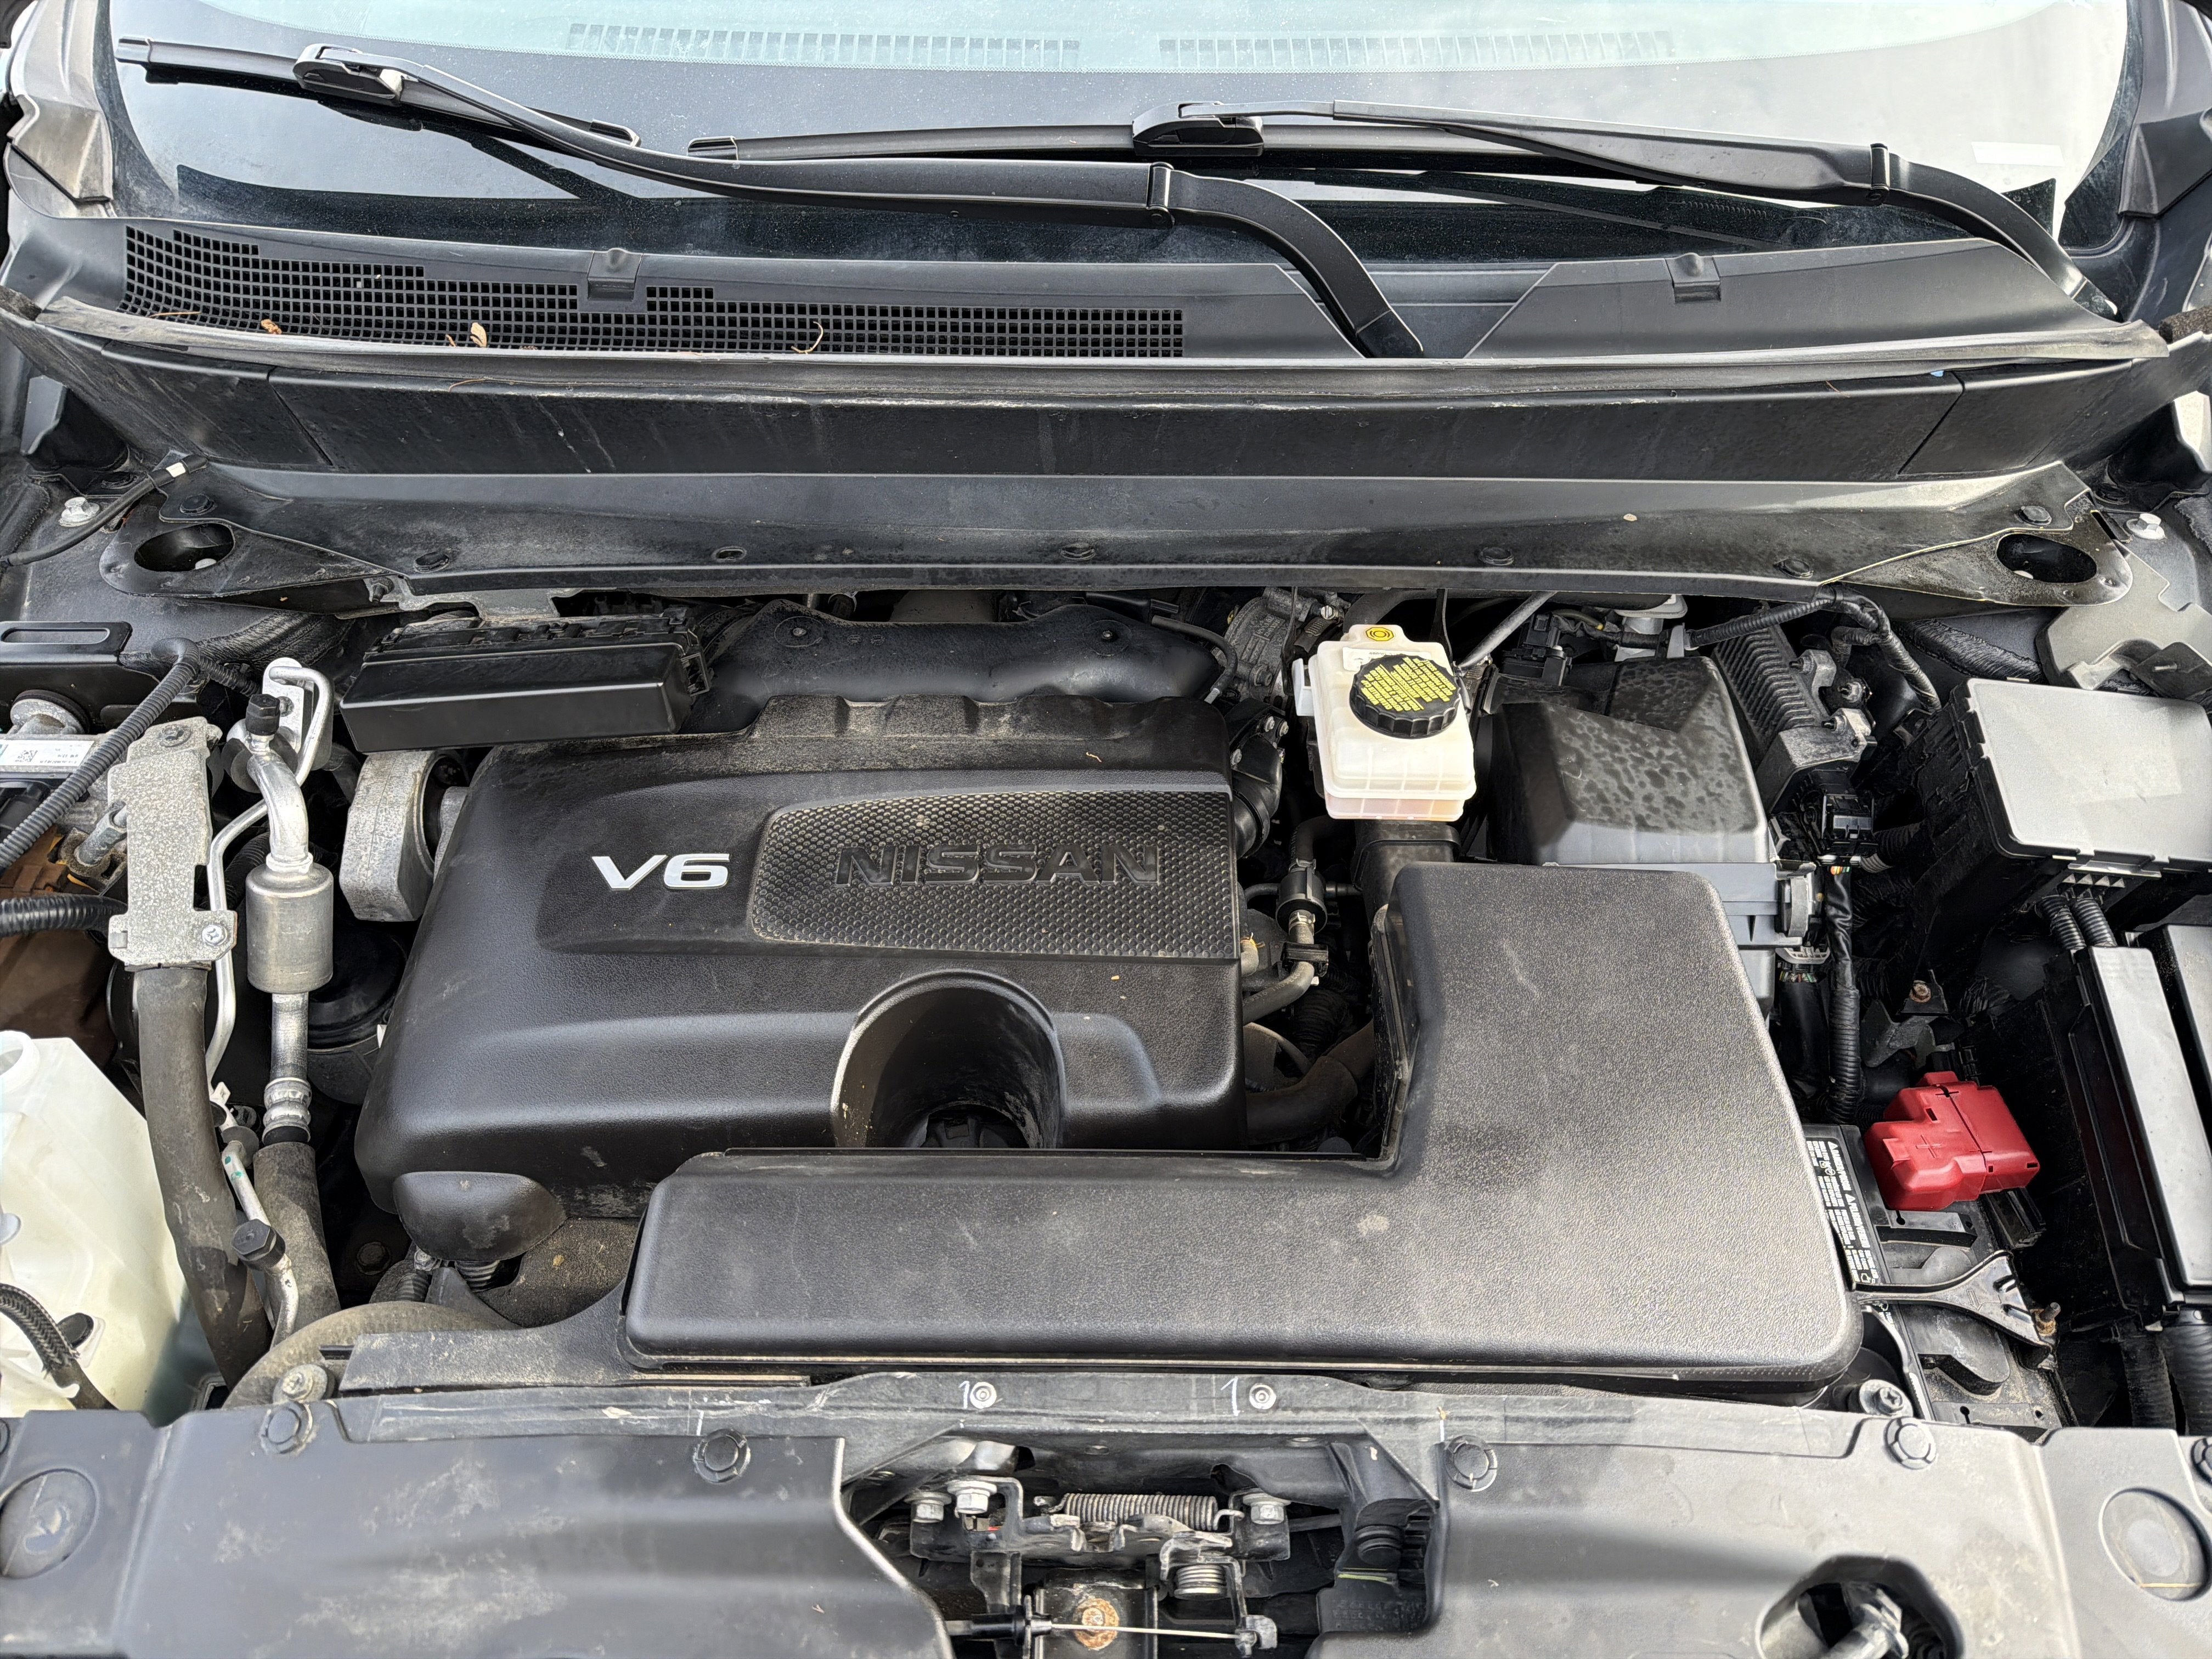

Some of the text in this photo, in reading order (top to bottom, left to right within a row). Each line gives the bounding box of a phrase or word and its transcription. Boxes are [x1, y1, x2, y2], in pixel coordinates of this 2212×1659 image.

[591, 853, 730, 891] V6
[836, 845, 1160, 887] NISSAN
[1831, 1150, 1851, 1190] DANGER/POISON
